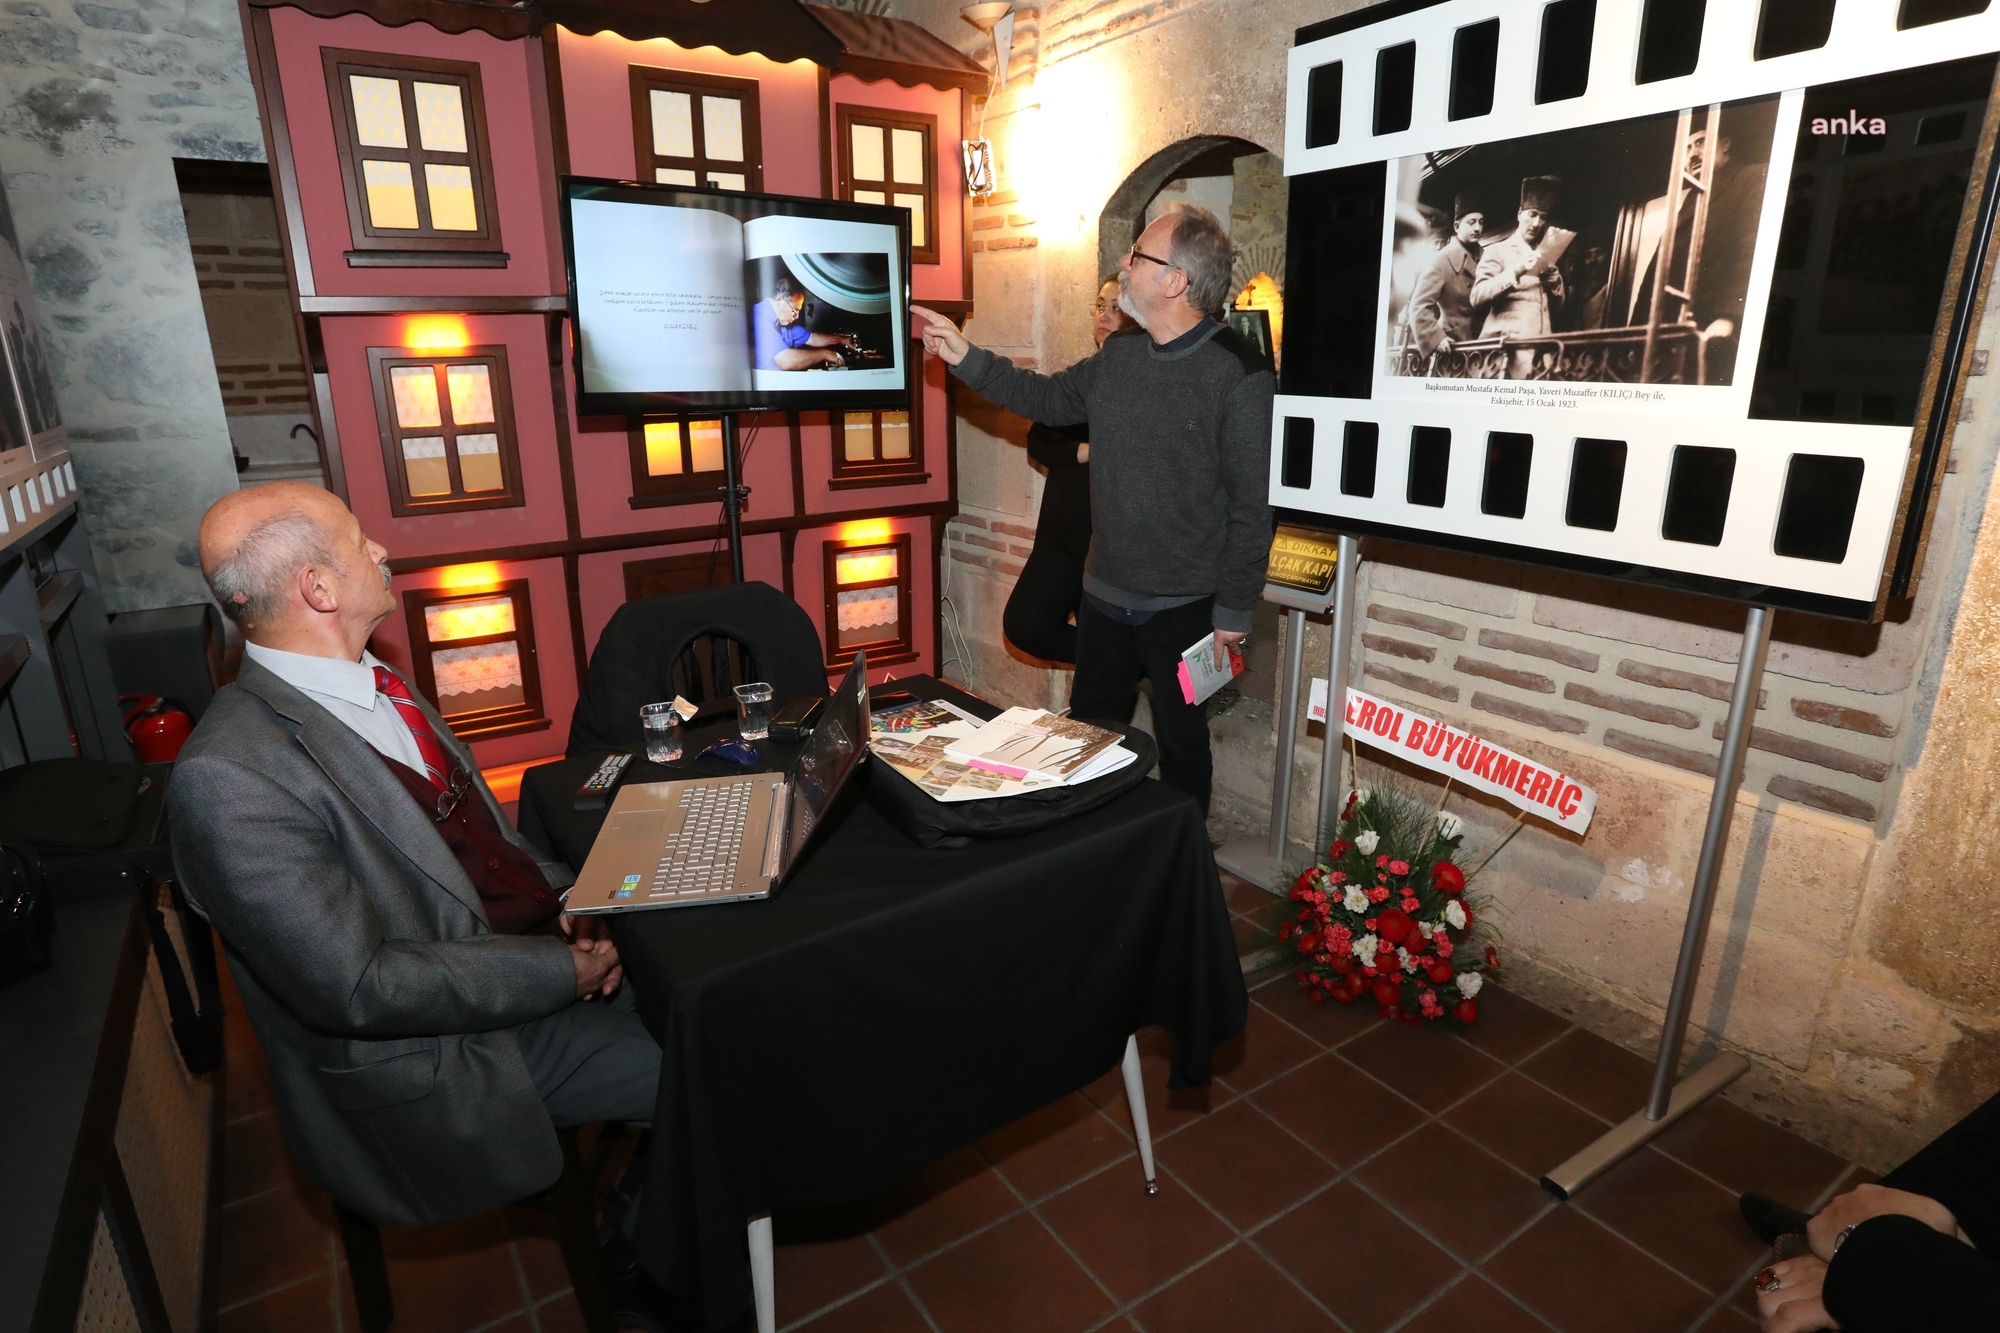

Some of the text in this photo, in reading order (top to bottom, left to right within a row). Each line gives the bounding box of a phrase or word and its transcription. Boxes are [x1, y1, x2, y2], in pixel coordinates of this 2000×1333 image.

[1425, 383, 1666, 401] Başkomutan Mustafa Kemal Paşa, Yaveri Muzaffer (KILIÇ) Bey ile,
[1490, 397, 1578, 408] Eskişehir, 15 Ocak 1923.
[1270, 555, 1333, 578] LÇAK KAPI
[1345, 696, 1583, 820] EROL BÜYÜKMERİÇ
